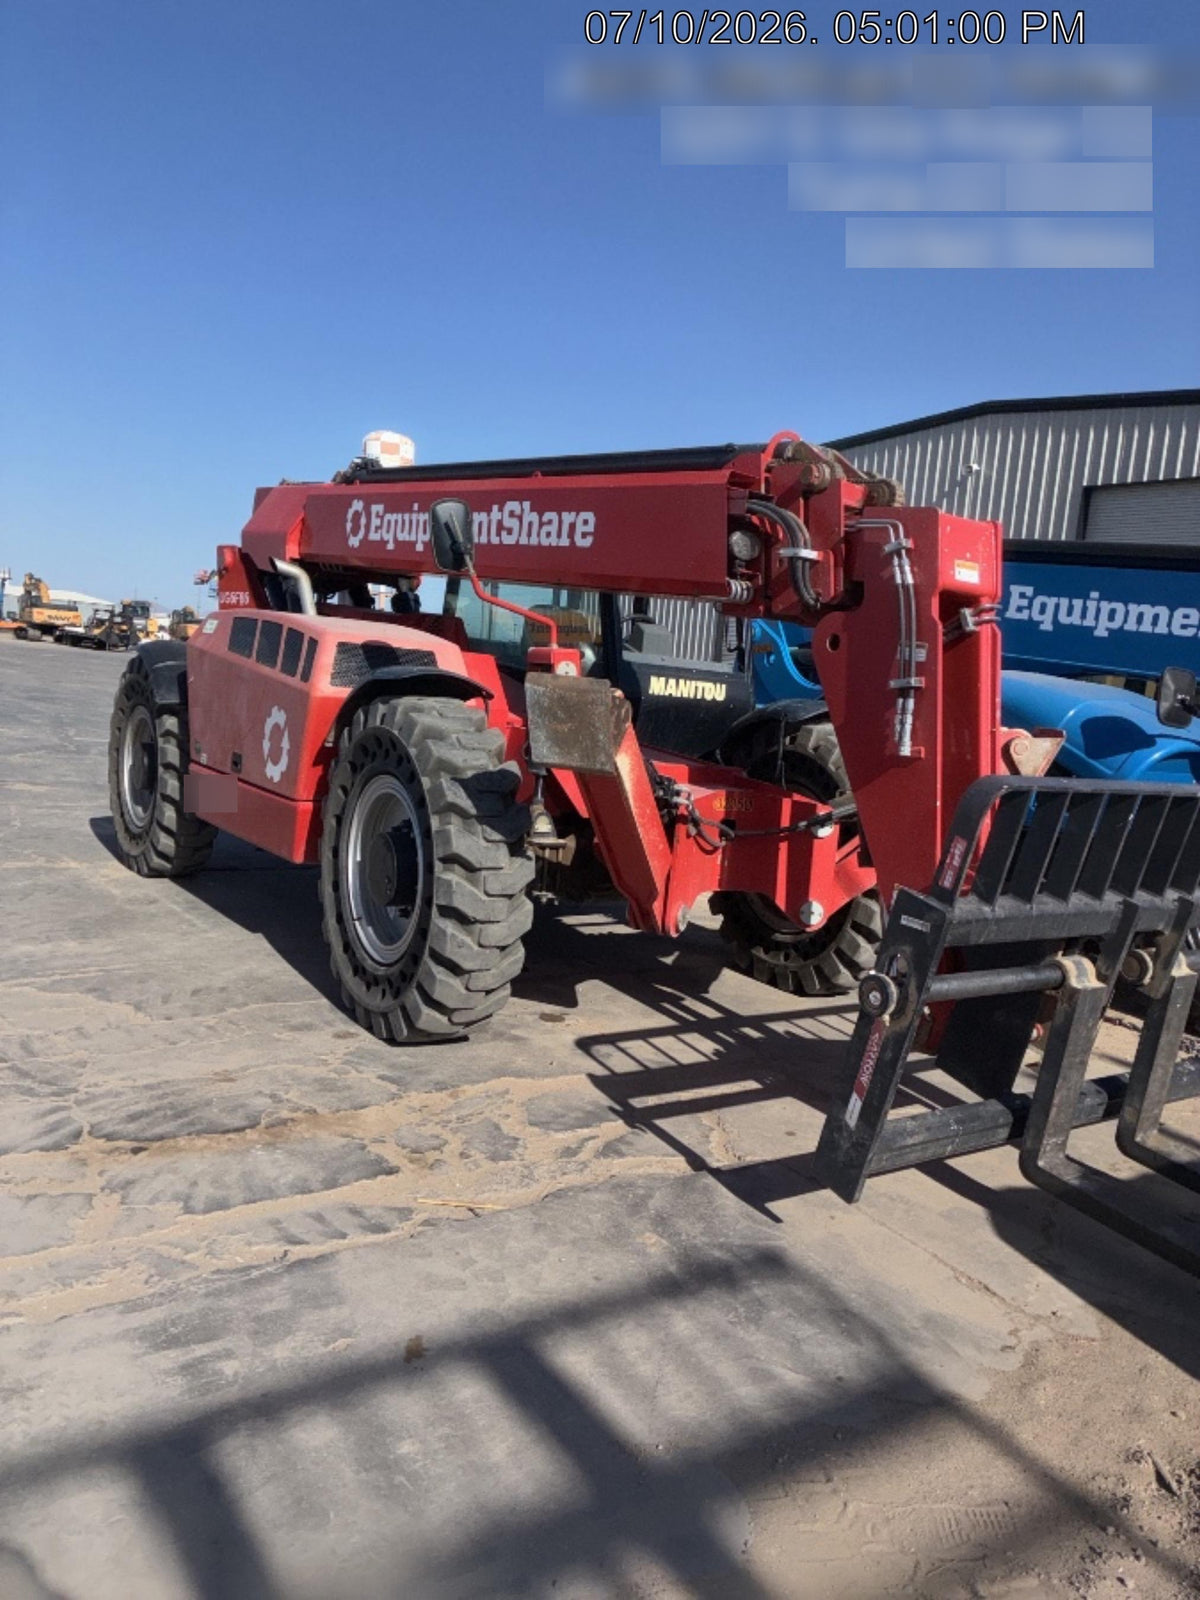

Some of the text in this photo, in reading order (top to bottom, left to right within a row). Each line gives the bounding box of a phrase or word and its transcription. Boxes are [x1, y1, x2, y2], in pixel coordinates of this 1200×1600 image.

[367, 500, 596, 551] EquipntShare
[1004, 584, 1200, 637] Equipme
[648, 675, 727, 701] MANITOU
